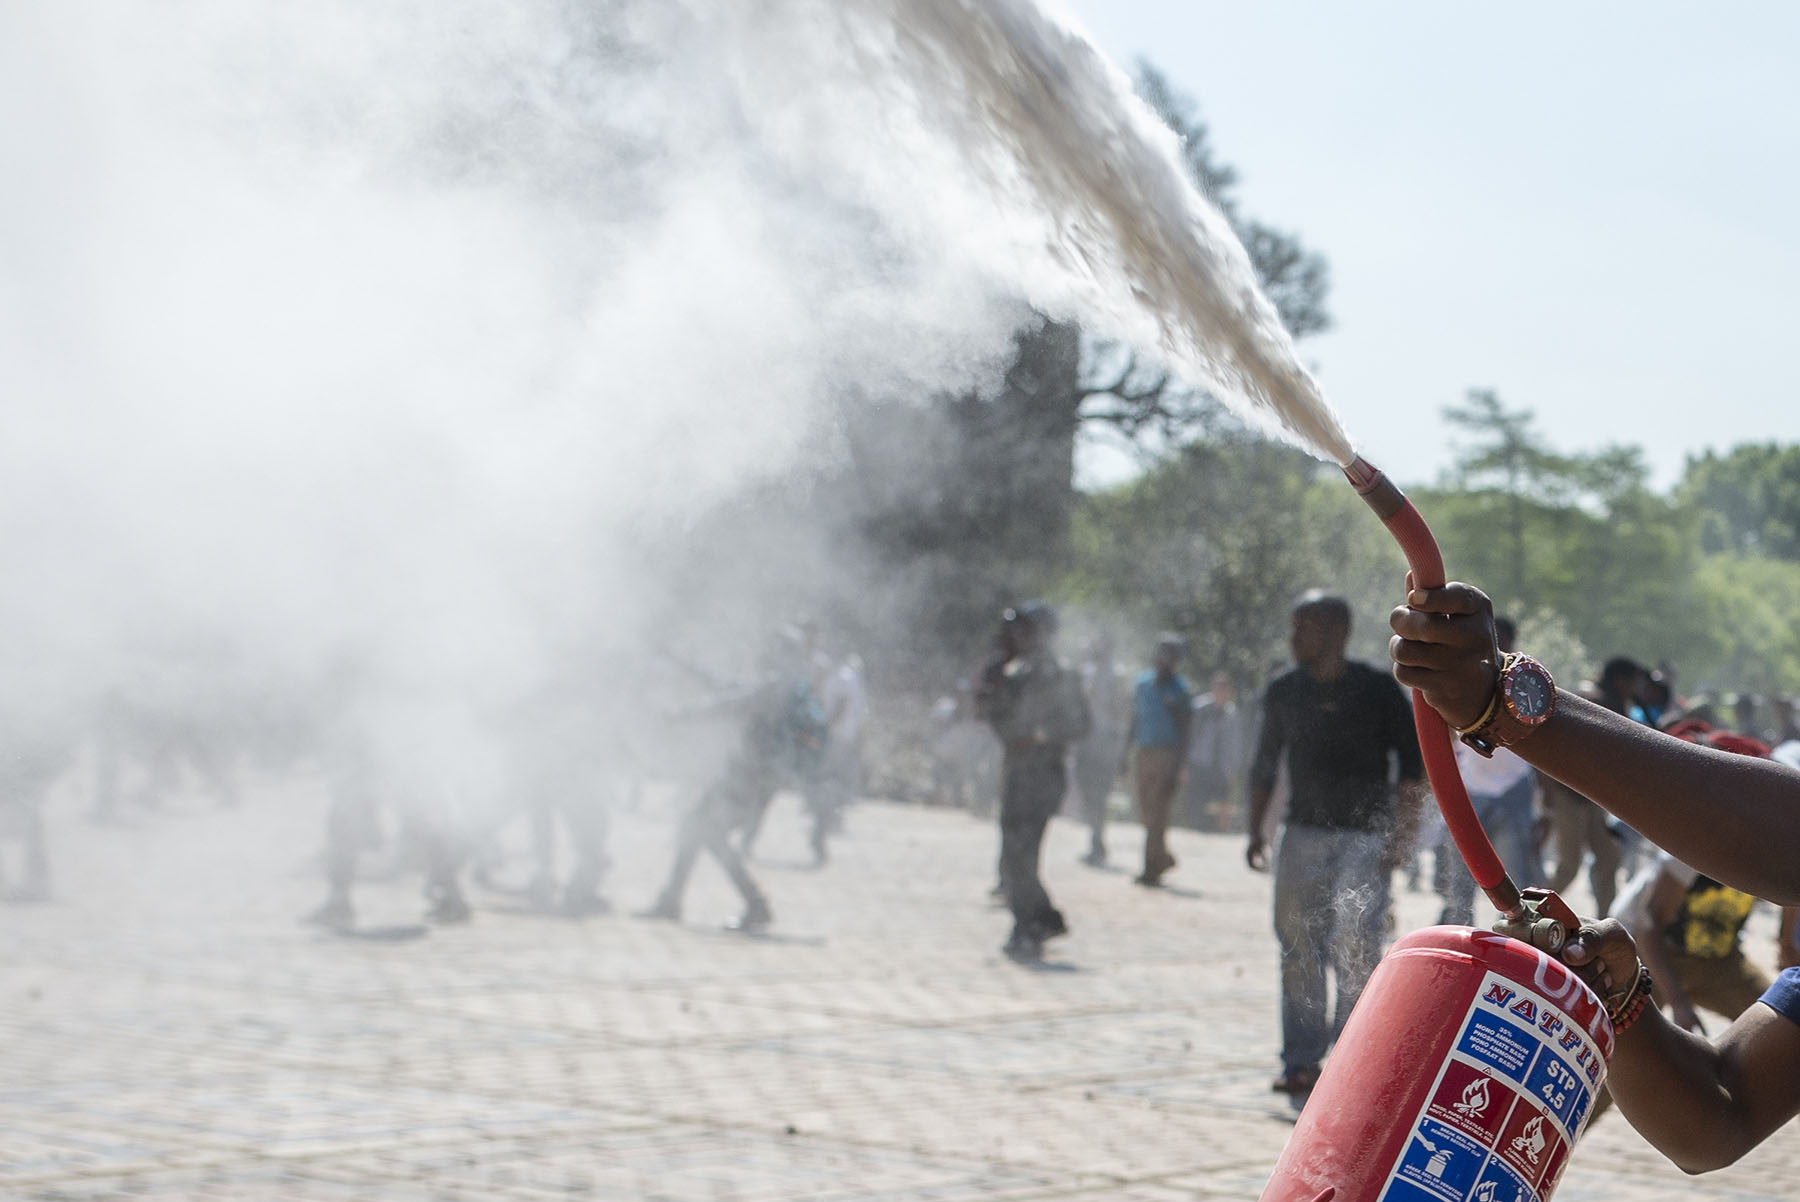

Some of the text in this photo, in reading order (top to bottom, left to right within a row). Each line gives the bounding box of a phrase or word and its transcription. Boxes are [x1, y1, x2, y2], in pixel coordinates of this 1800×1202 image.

[1469, 1035, 1523, 1067] MONO AMMONIUM
[1472, 1029, 1525, 1060] PHOSPHATE BASE
[1474, 1022, 1529, 1054] MONO AMMONIUM
[1547, 1059, 1576, 1091] STP
[1542, 1083, 1566, 1110] 4.5
[1421, 1118, 1429, 1126] 1
[1489, 1156, 1498, 1165] 2
